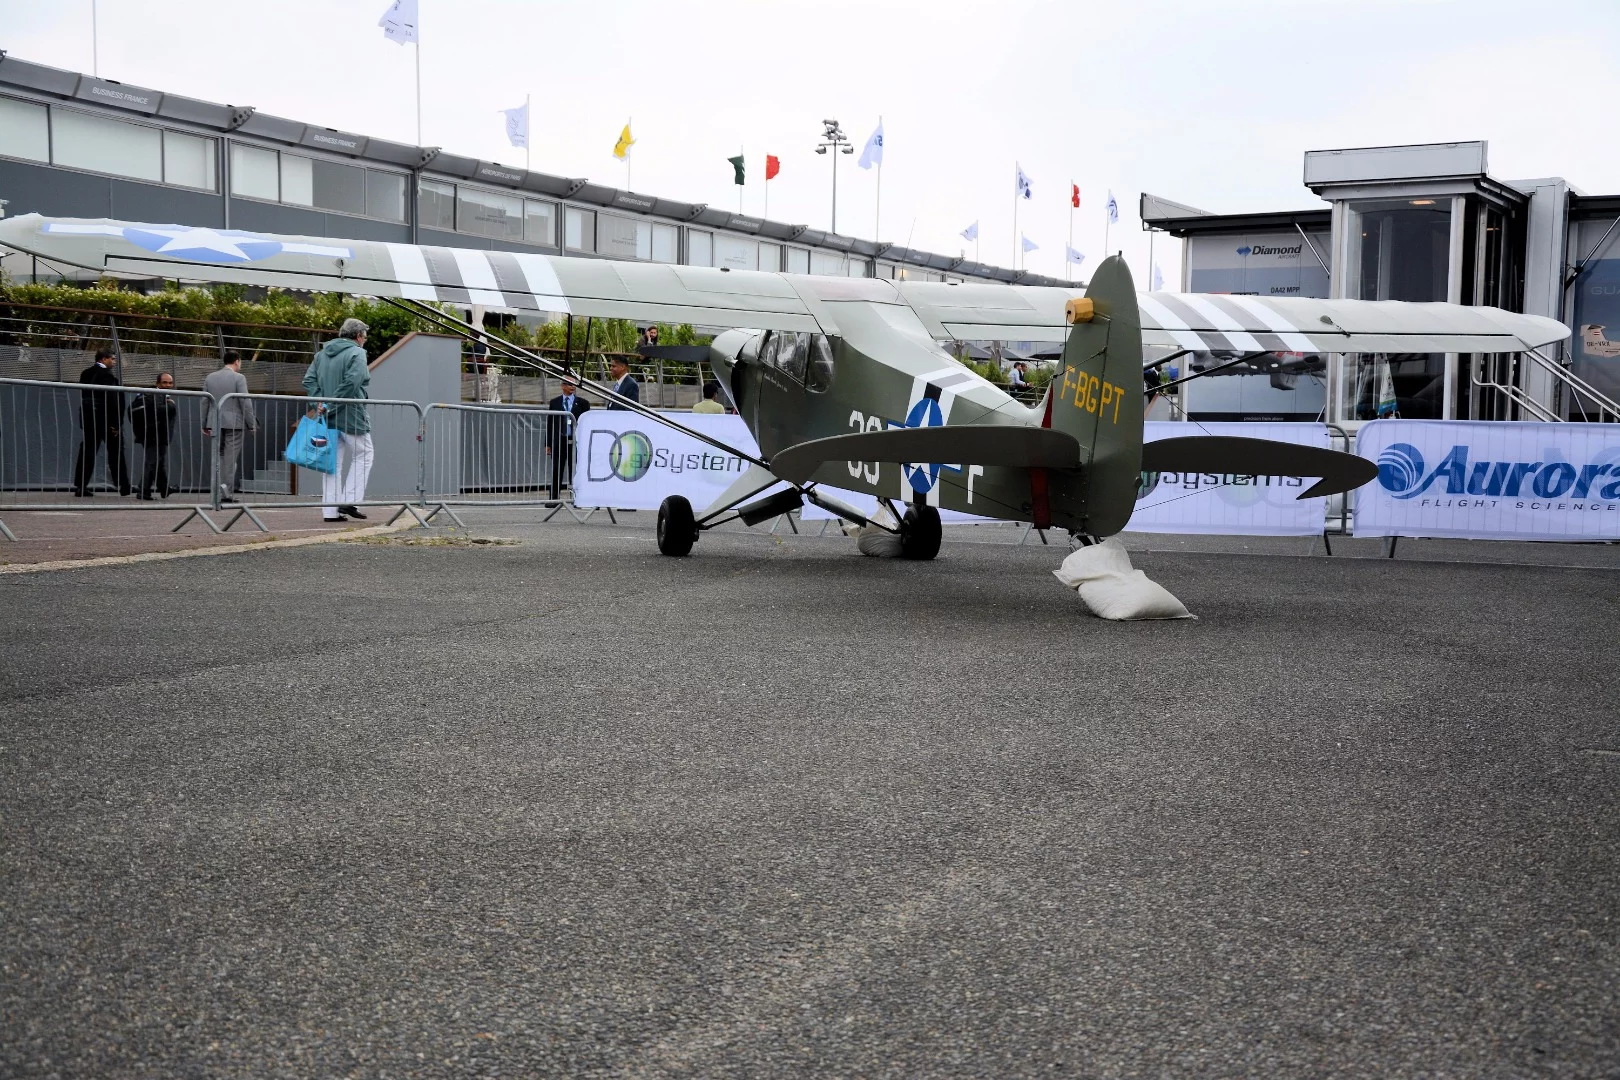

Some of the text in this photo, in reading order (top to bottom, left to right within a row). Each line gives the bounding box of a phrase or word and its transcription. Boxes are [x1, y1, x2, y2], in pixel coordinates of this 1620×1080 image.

[92, 86, 149, 105] BUSINESS FRANCE
[313, 134, 338, 145] BUSINESS
[1252, 244, 1302, 256] Diamond
[1270, 286, 1286, 294] DA42
[1060, 365, 1125, 425] F-BGPT
[654, 448, 752, 474] System
[1420, 499, 1617, 511] FLIGHT SCIENCE
